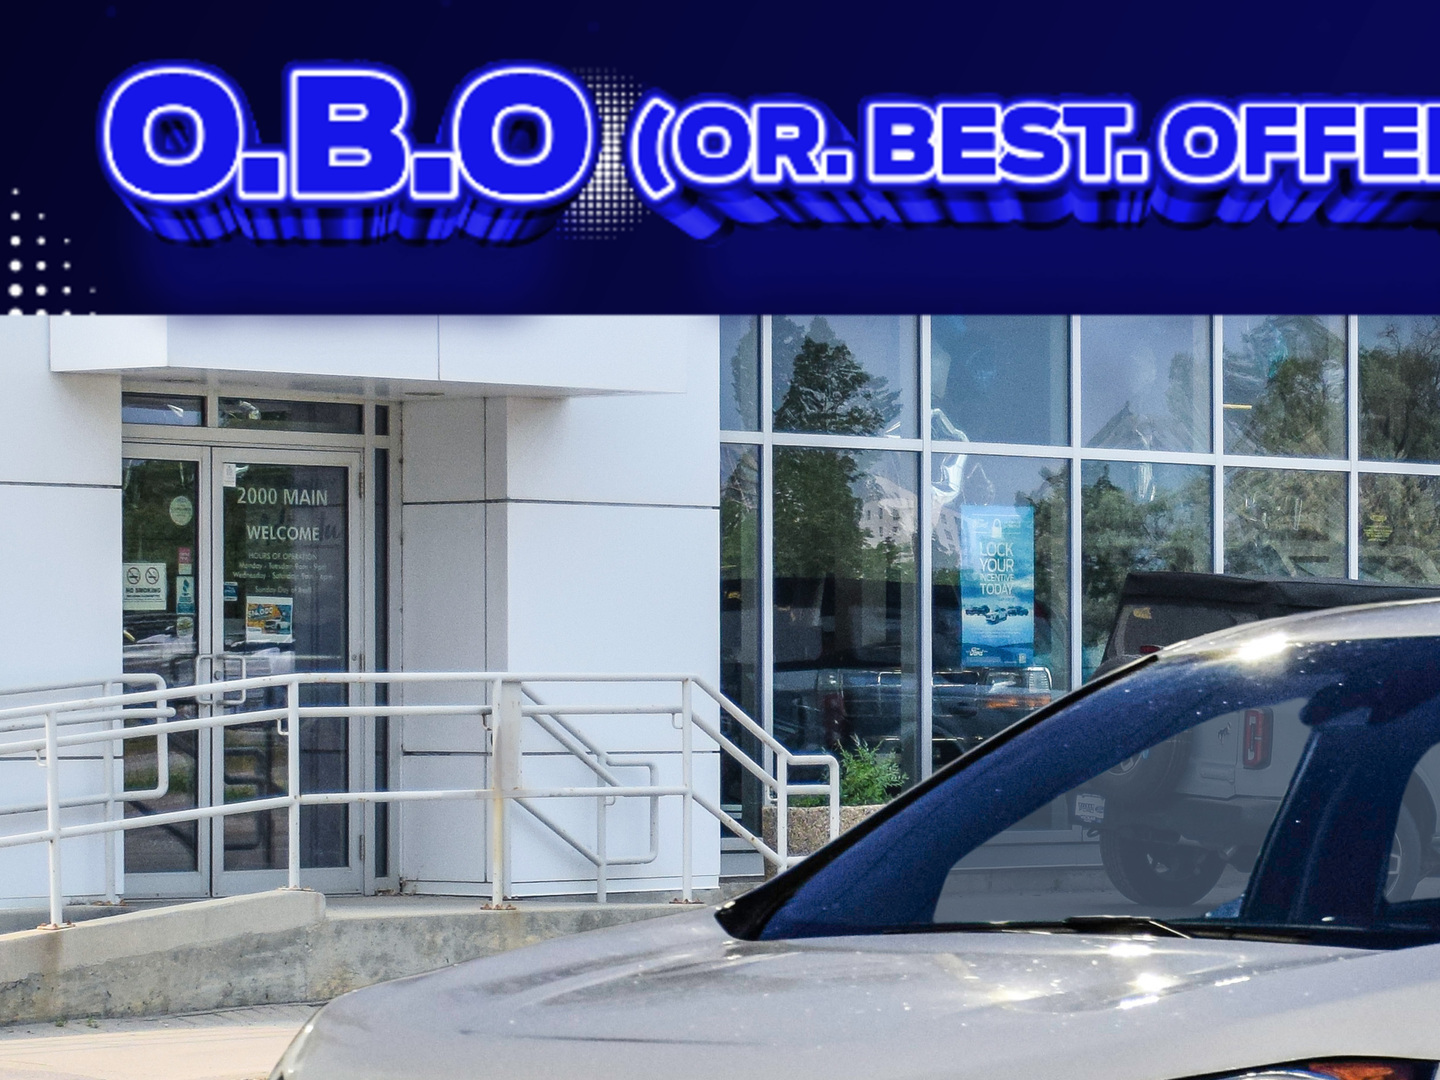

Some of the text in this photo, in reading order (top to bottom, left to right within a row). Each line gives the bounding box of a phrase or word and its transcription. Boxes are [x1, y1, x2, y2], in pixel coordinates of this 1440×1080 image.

[237, 487, 328, 506] 2000 MAIN
[246, 525, 320, 541] WELCOME
[979, 541, 1014, 557] LOCK
[979, 558, 1015, 572] YOUR
[979, 583, 1014, 595] TODAY
